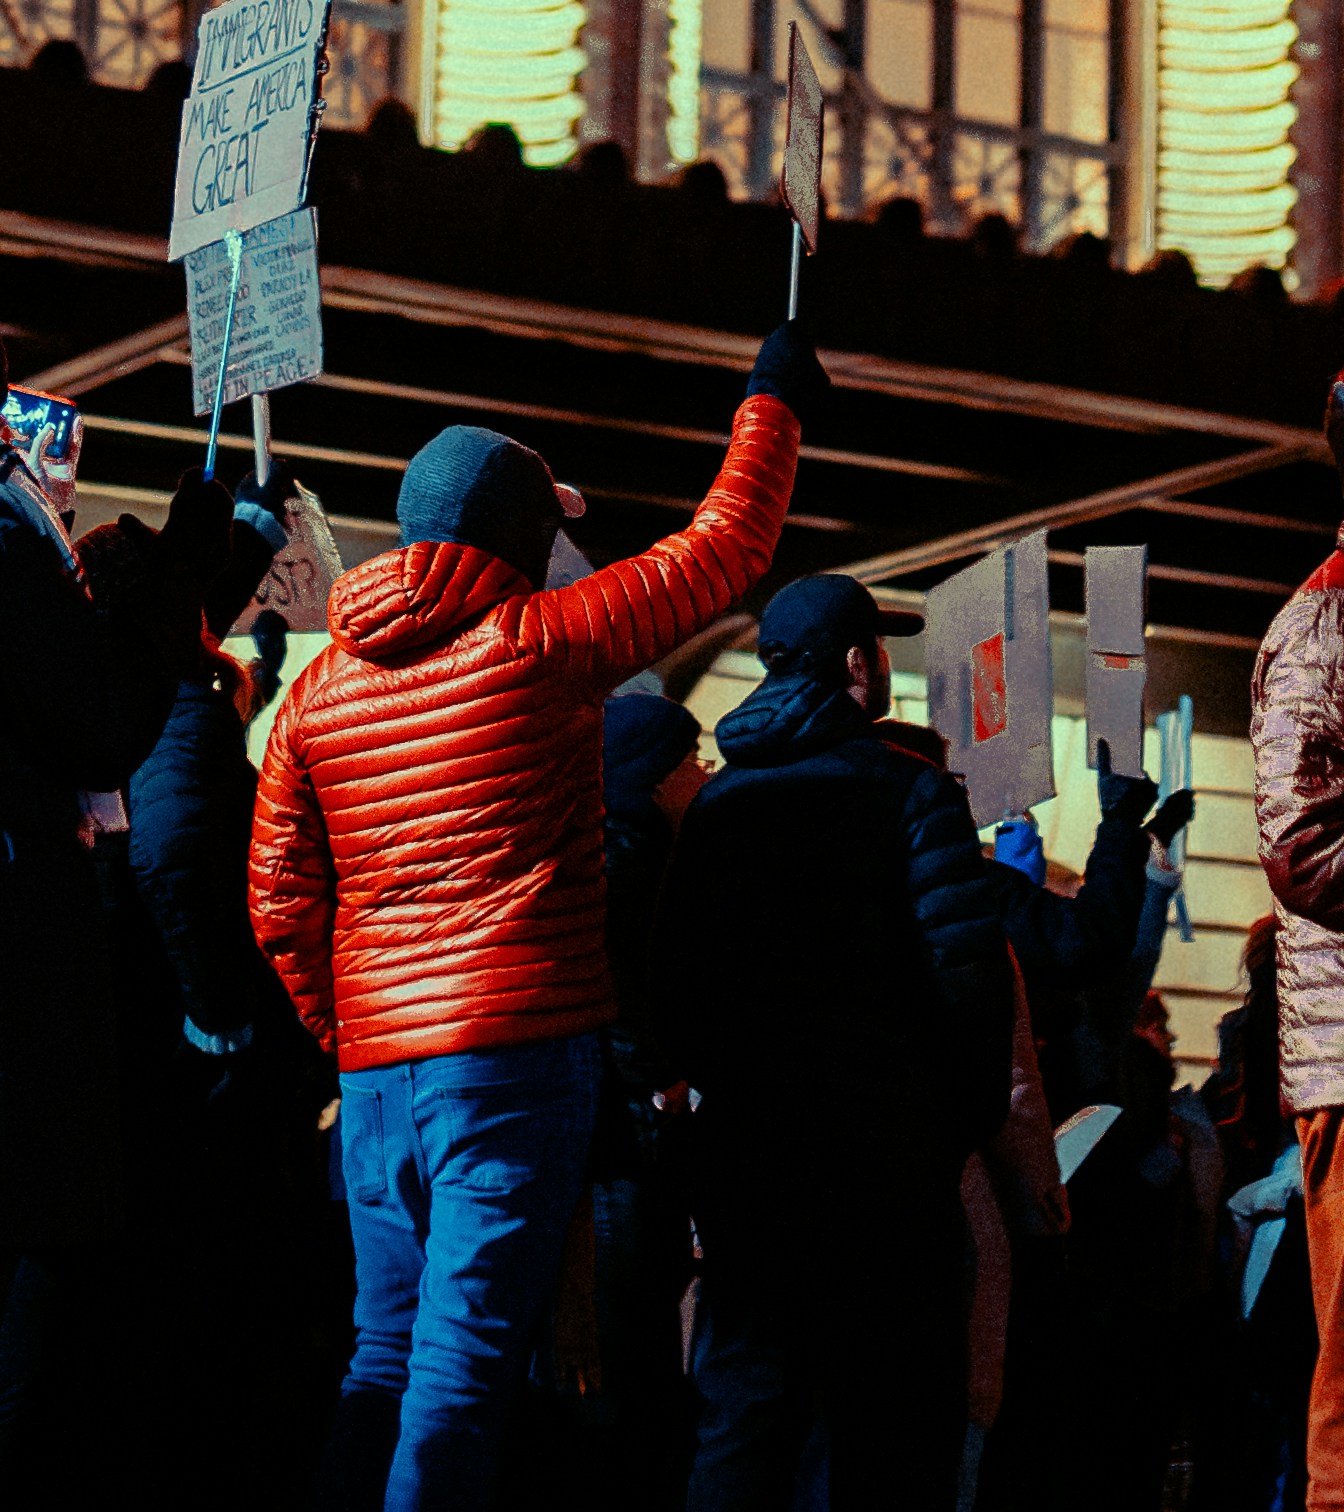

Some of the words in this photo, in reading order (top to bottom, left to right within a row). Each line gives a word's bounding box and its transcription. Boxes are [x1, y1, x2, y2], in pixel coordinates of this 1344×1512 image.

[184, 88, 234, 146] MAKE
[244, 56, 306, 127] AMERICA
[191, 118, 269, 215] GREAT
